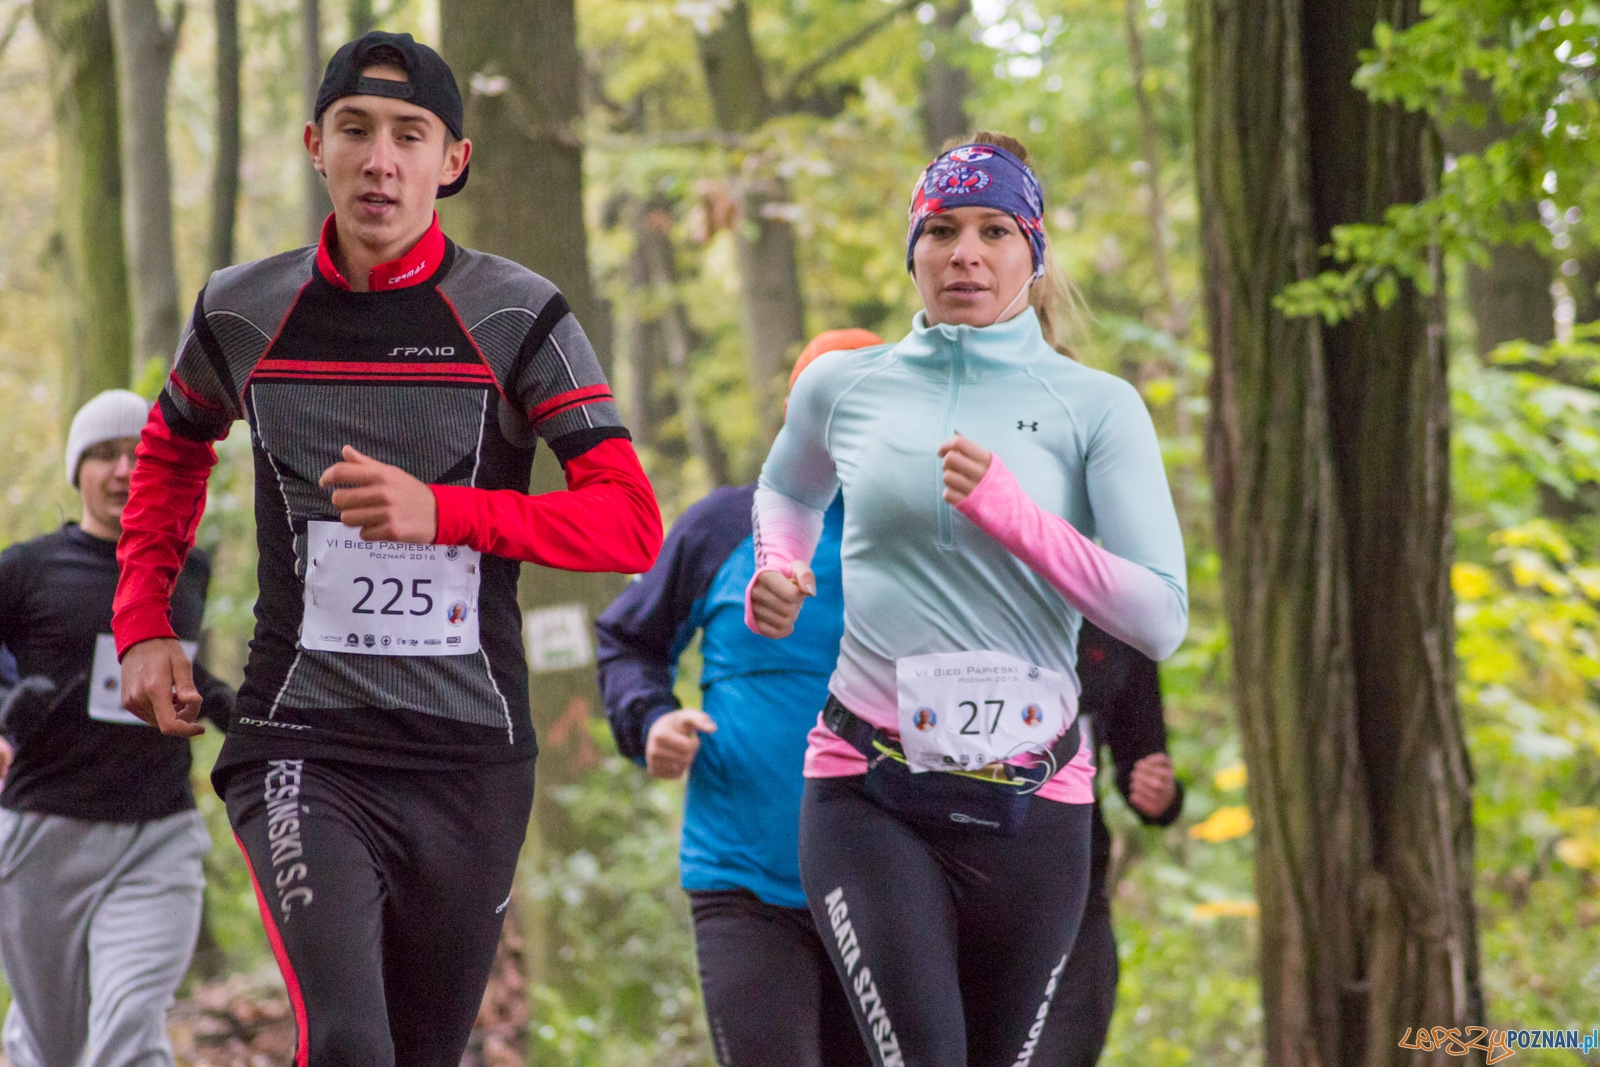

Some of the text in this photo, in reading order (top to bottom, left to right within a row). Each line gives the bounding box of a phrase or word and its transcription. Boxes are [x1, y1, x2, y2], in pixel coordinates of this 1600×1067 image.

[387, 346, 455, 356] SPAIO
[326, 539, 338, 548] VI
[344, 540, 373, 550] BIEG
[351, 576, 434, 616] 225
[915, 670, 928, 678] VI
[958, 700, 1005, 735] 27
[825, 886, 861, 977] AGATA
